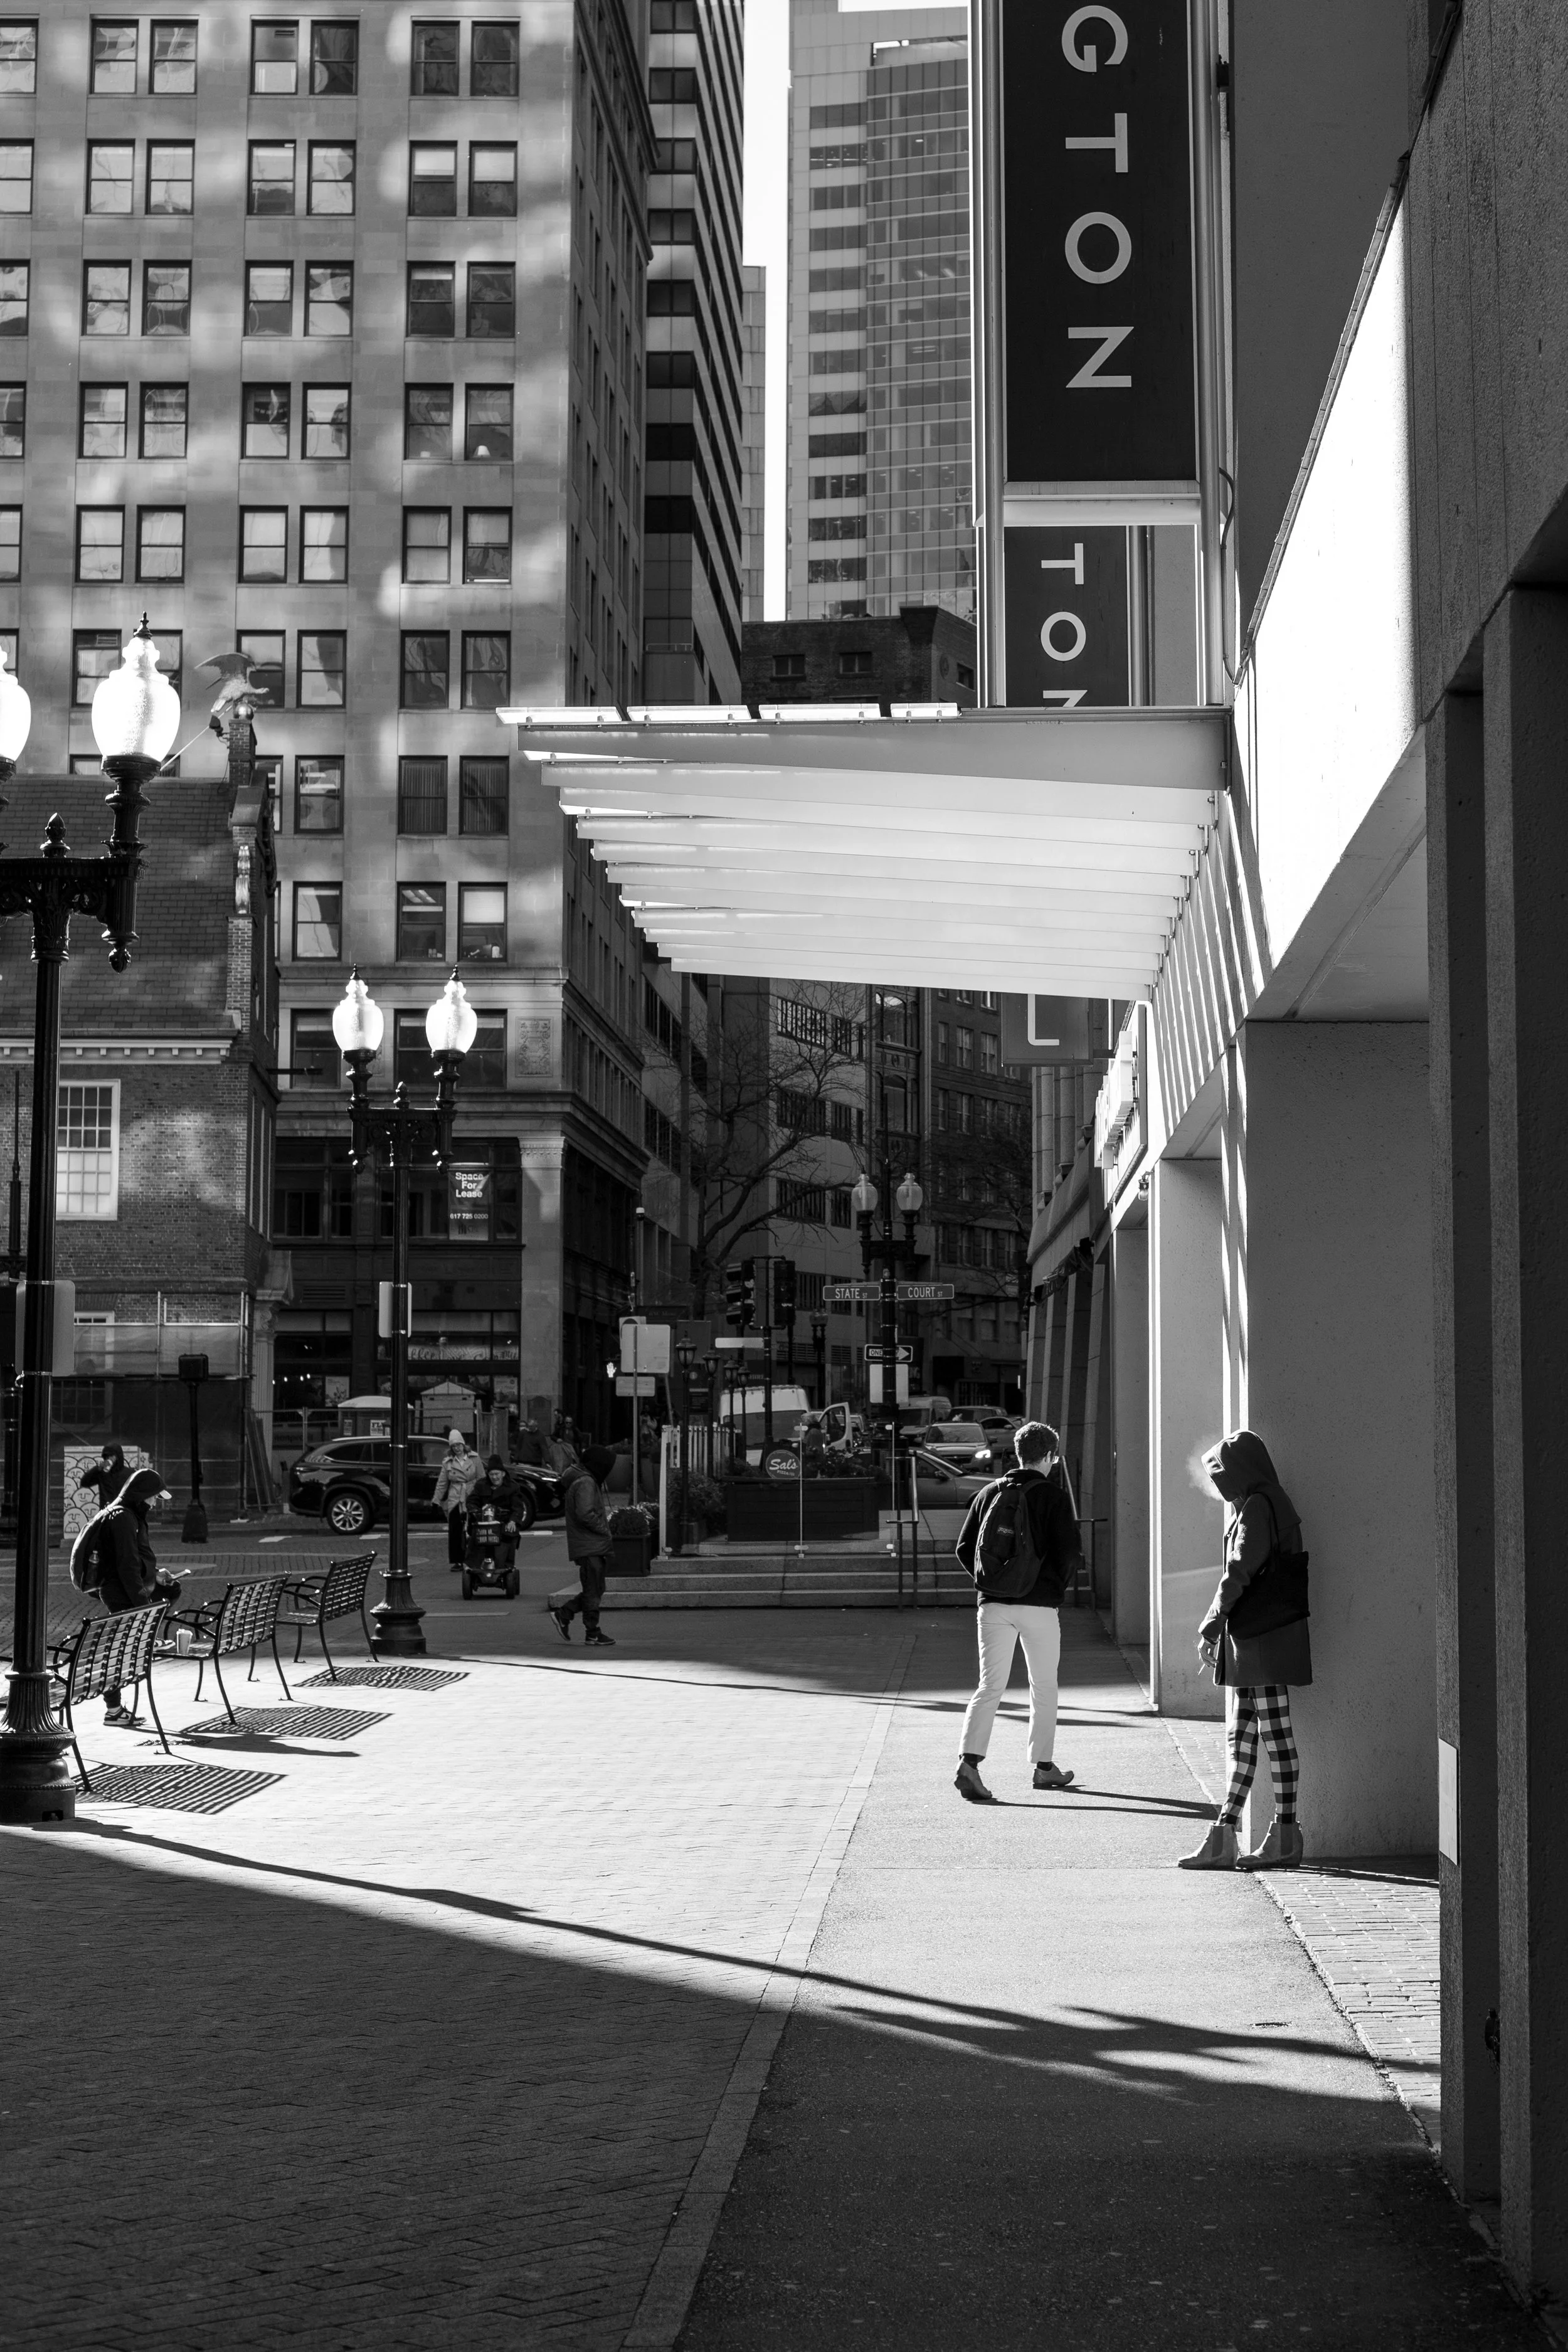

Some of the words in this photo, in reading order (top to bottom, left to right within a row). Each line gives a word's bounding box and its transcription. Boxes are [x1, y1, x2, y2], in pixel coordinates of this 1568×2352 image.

[455, 1172, 484, 1181] Space
[462, 1181, 477, 1189] For
[456, 1189, 482, 1198] Lease
[835, 1288, 860, 1299] STATE
[908, 1287, 935, 1298] COURT
[769, 1458, 798, 1470] Sal's
